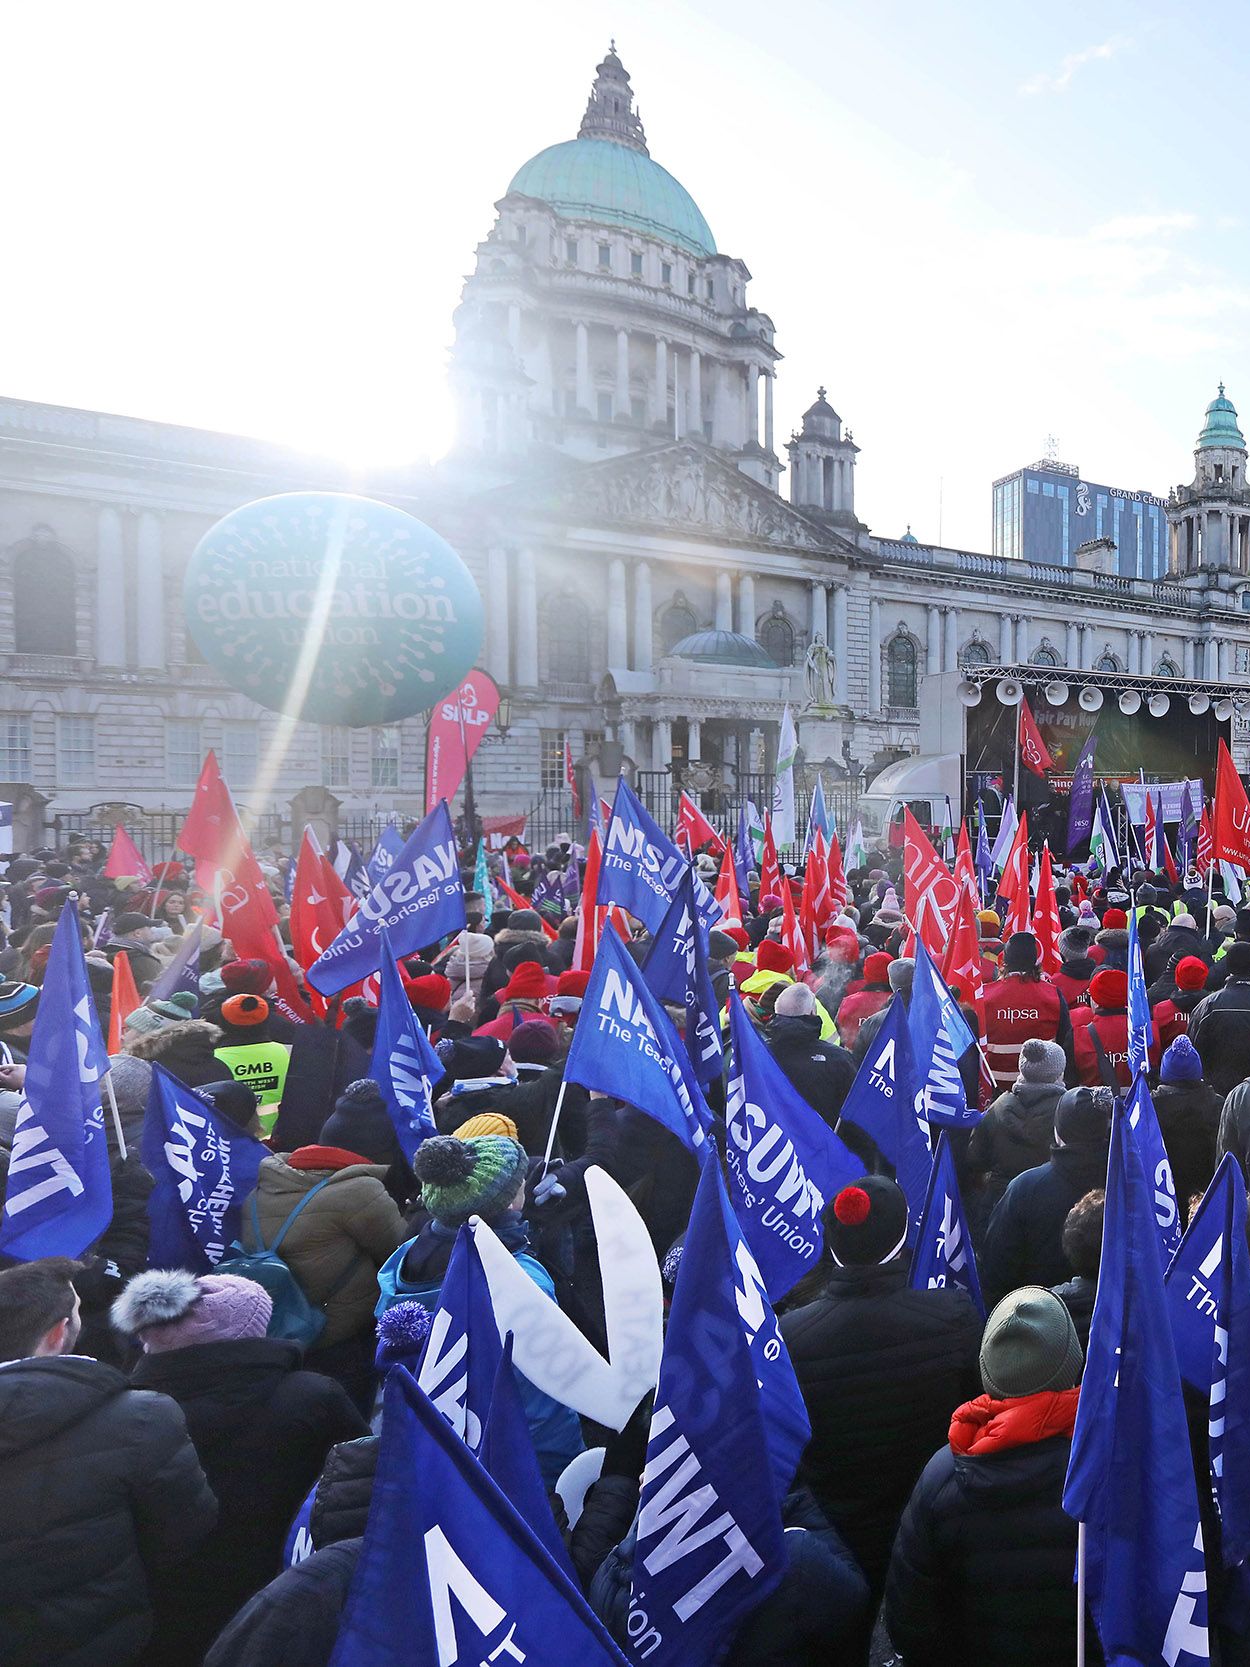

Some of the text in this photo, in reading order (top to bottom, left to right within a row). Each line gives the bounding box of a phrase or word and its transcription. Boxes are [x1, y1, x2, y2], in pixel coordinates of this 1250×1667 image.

[1110, 488, 1170, 508] GRAND CENTR
[248, 555, 389, 580] national
[199, 580, 458, 623] education
[442, 704, 489, 726] SDLP
[1056, 711, 1078, 729] Pay
[605, 852, 632, 872] The
[997, 1008, 1039, 1023] nipsa
[597, 1013, 632, 1043] The
[235, 1062, 273, 1075] GMB
[867, 1071, 895, 1098] The
[762, 1208, 815, 1260] Union
